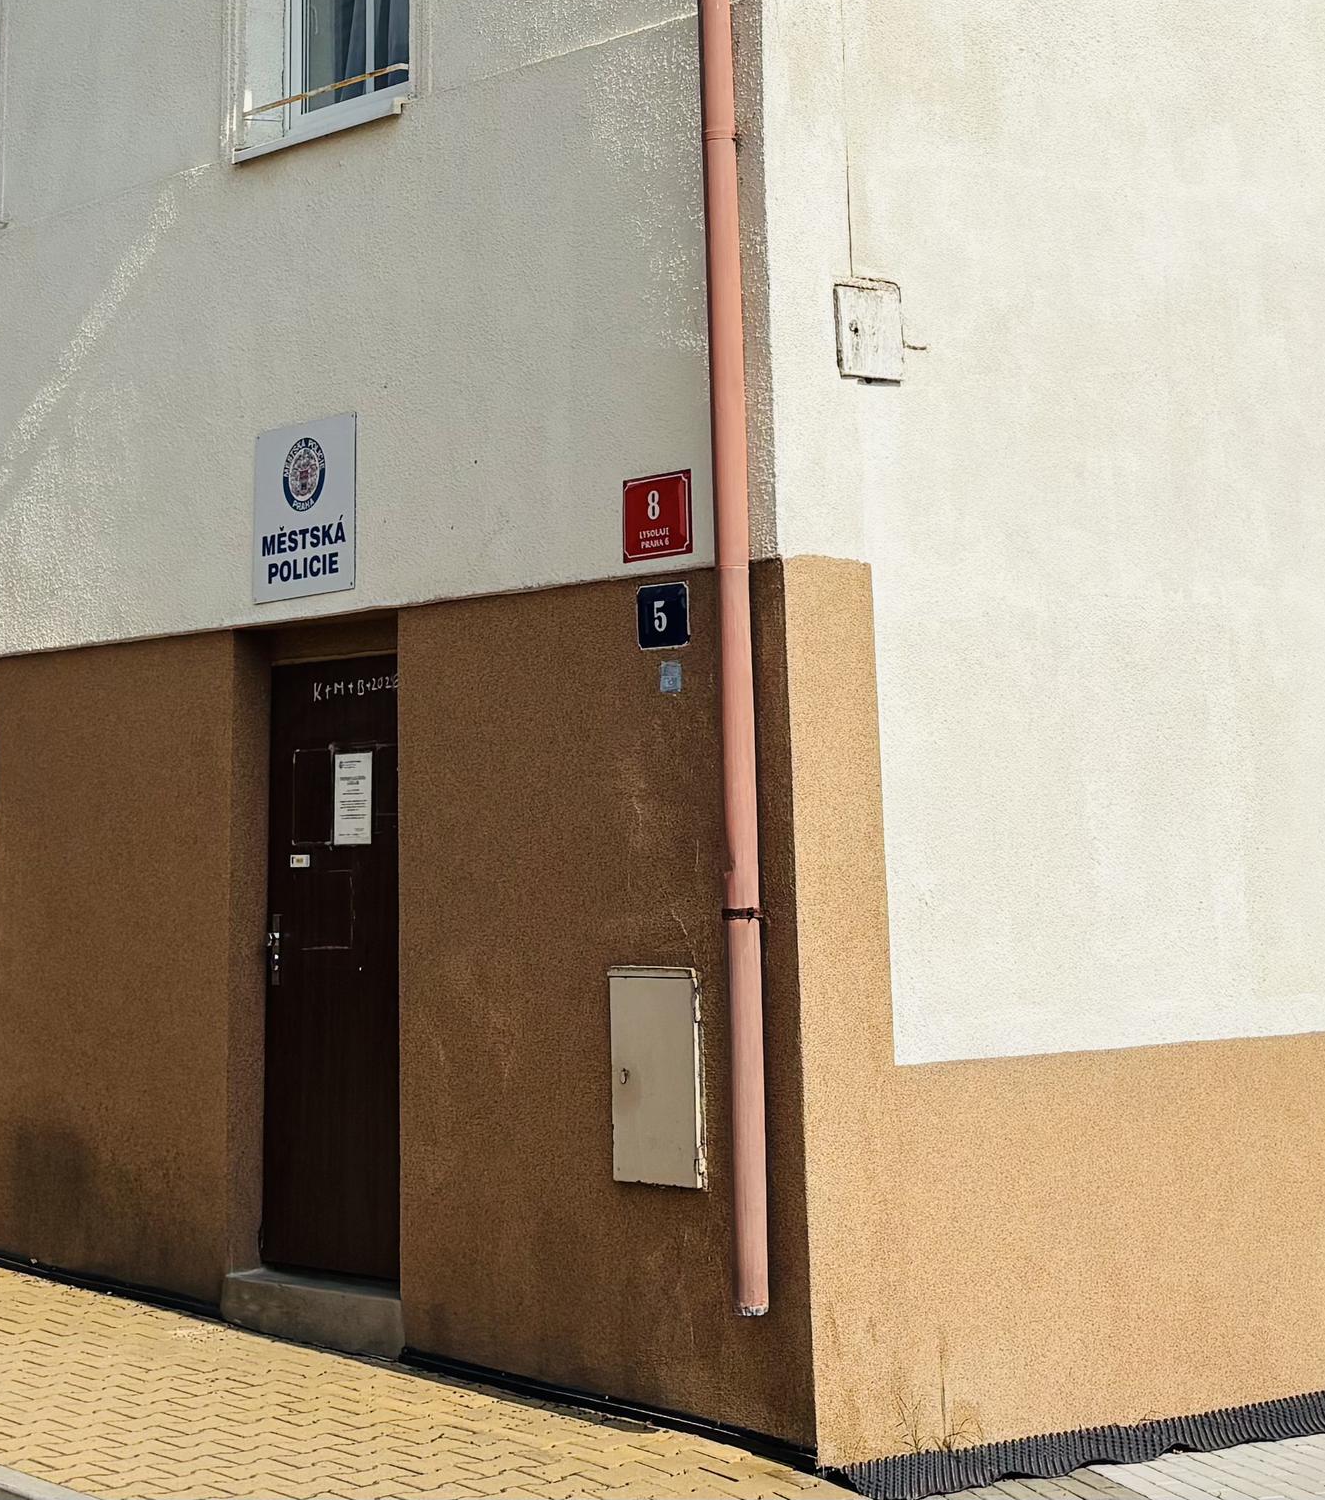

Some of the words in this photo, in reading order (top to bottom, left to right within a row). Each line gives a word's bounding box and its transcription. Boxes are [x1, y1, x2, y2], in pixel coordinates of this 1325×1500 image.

[647, 490, 660, 520] 8
[262, 514, 346, 557] MĚSTSKÁ
[268, 552, 339, 584] POLICIE
[653, 600, 667, 632] 5
